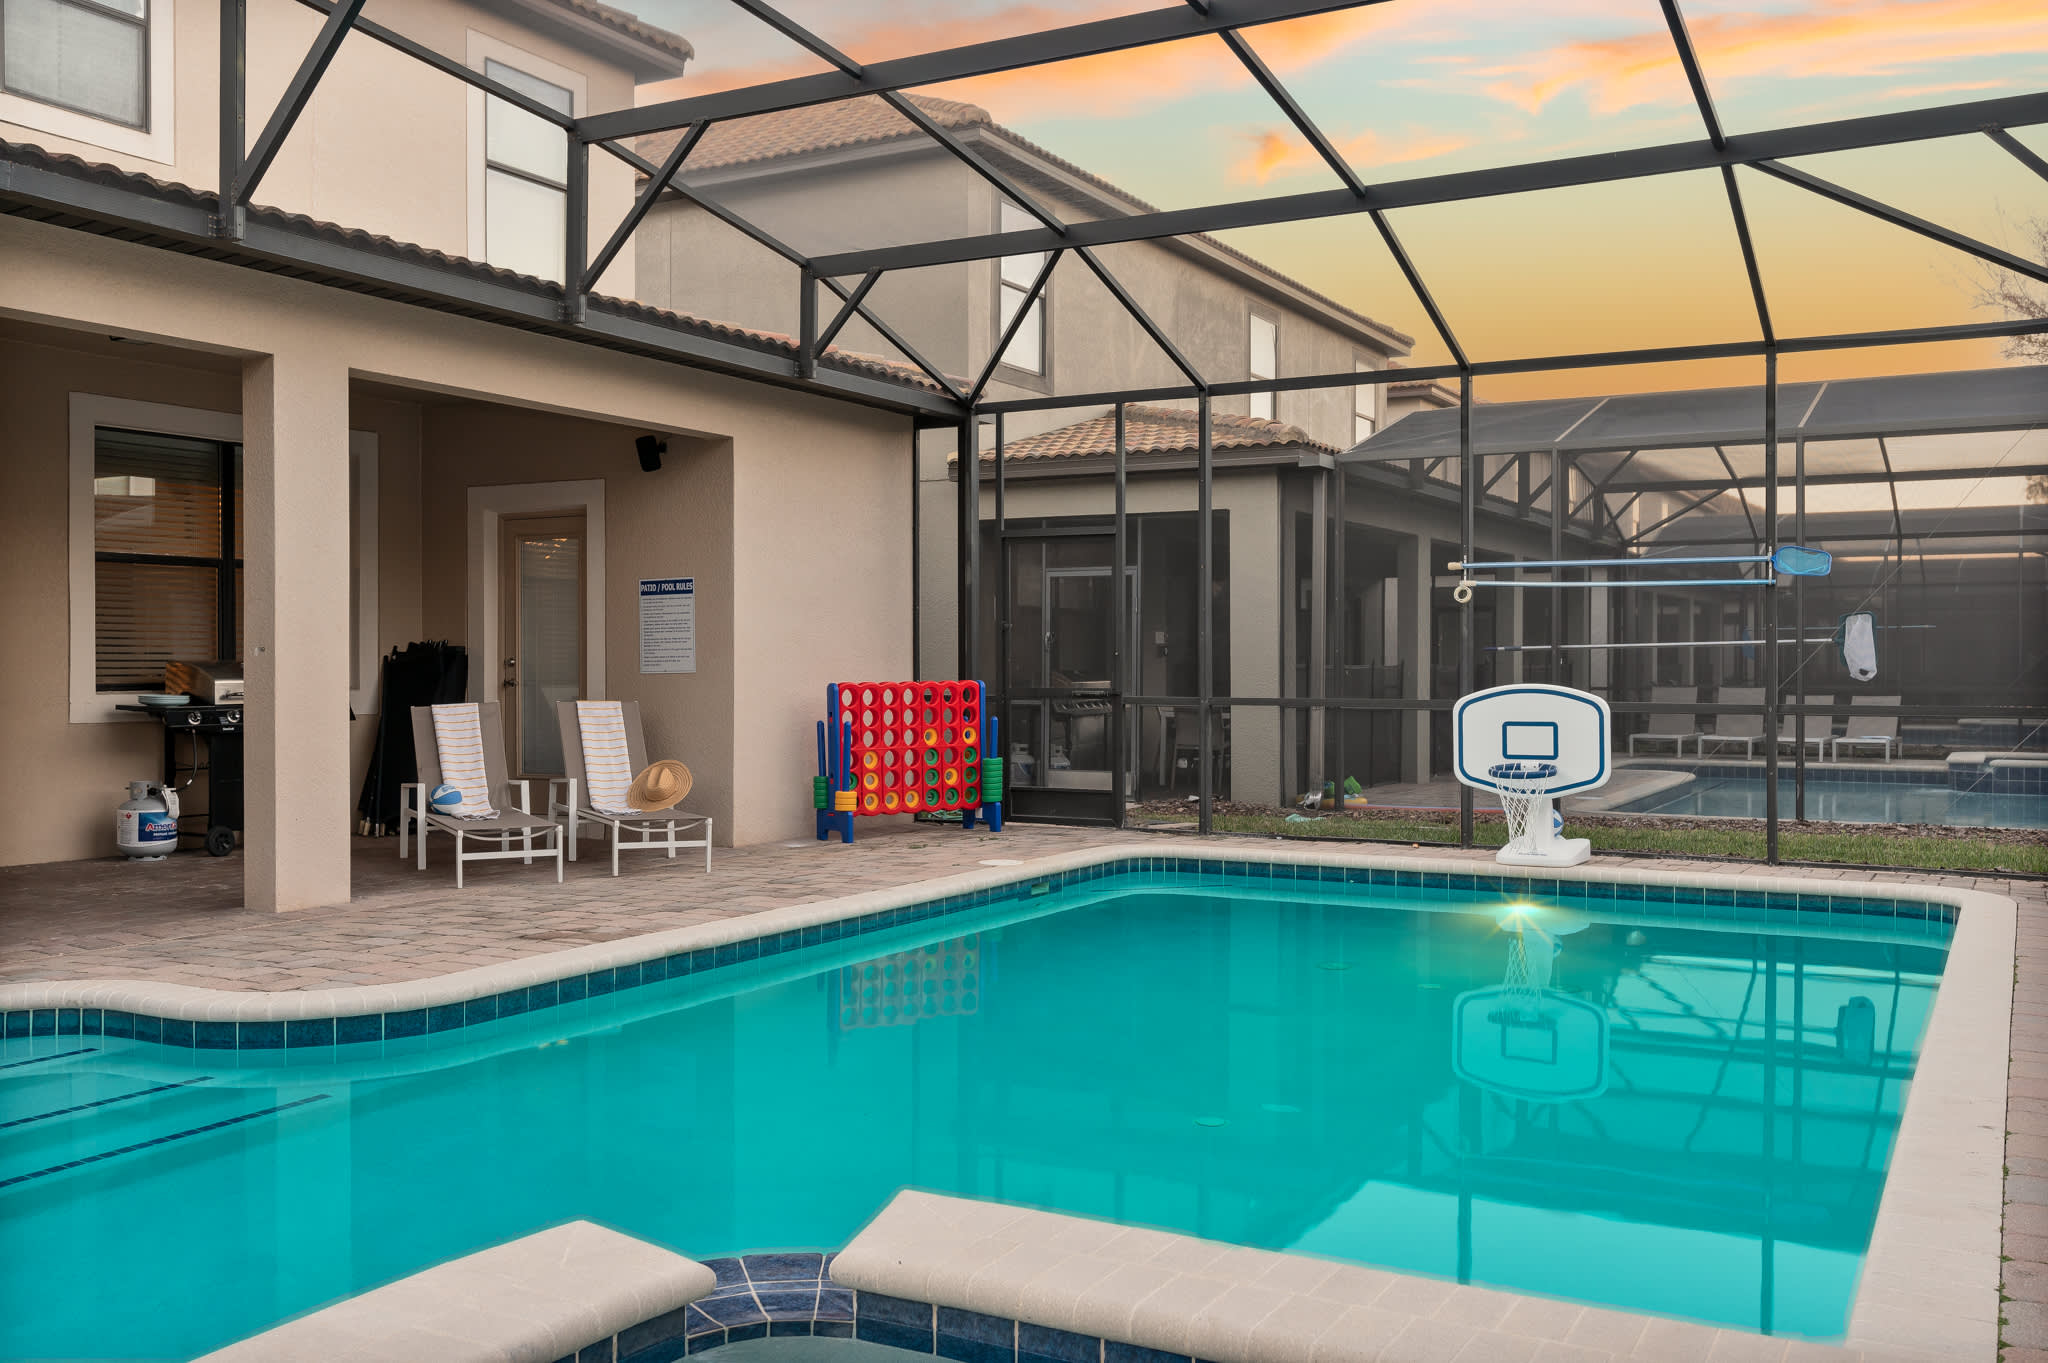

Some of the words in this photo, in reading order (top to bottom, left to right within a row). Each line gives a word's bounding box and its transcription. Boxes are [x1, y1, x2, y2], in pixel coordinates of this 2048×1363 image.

[641, 584, 657, 592] PATIO
[662, 583, 676, 592] POOL
[676, 582, 693, 590] RULES
